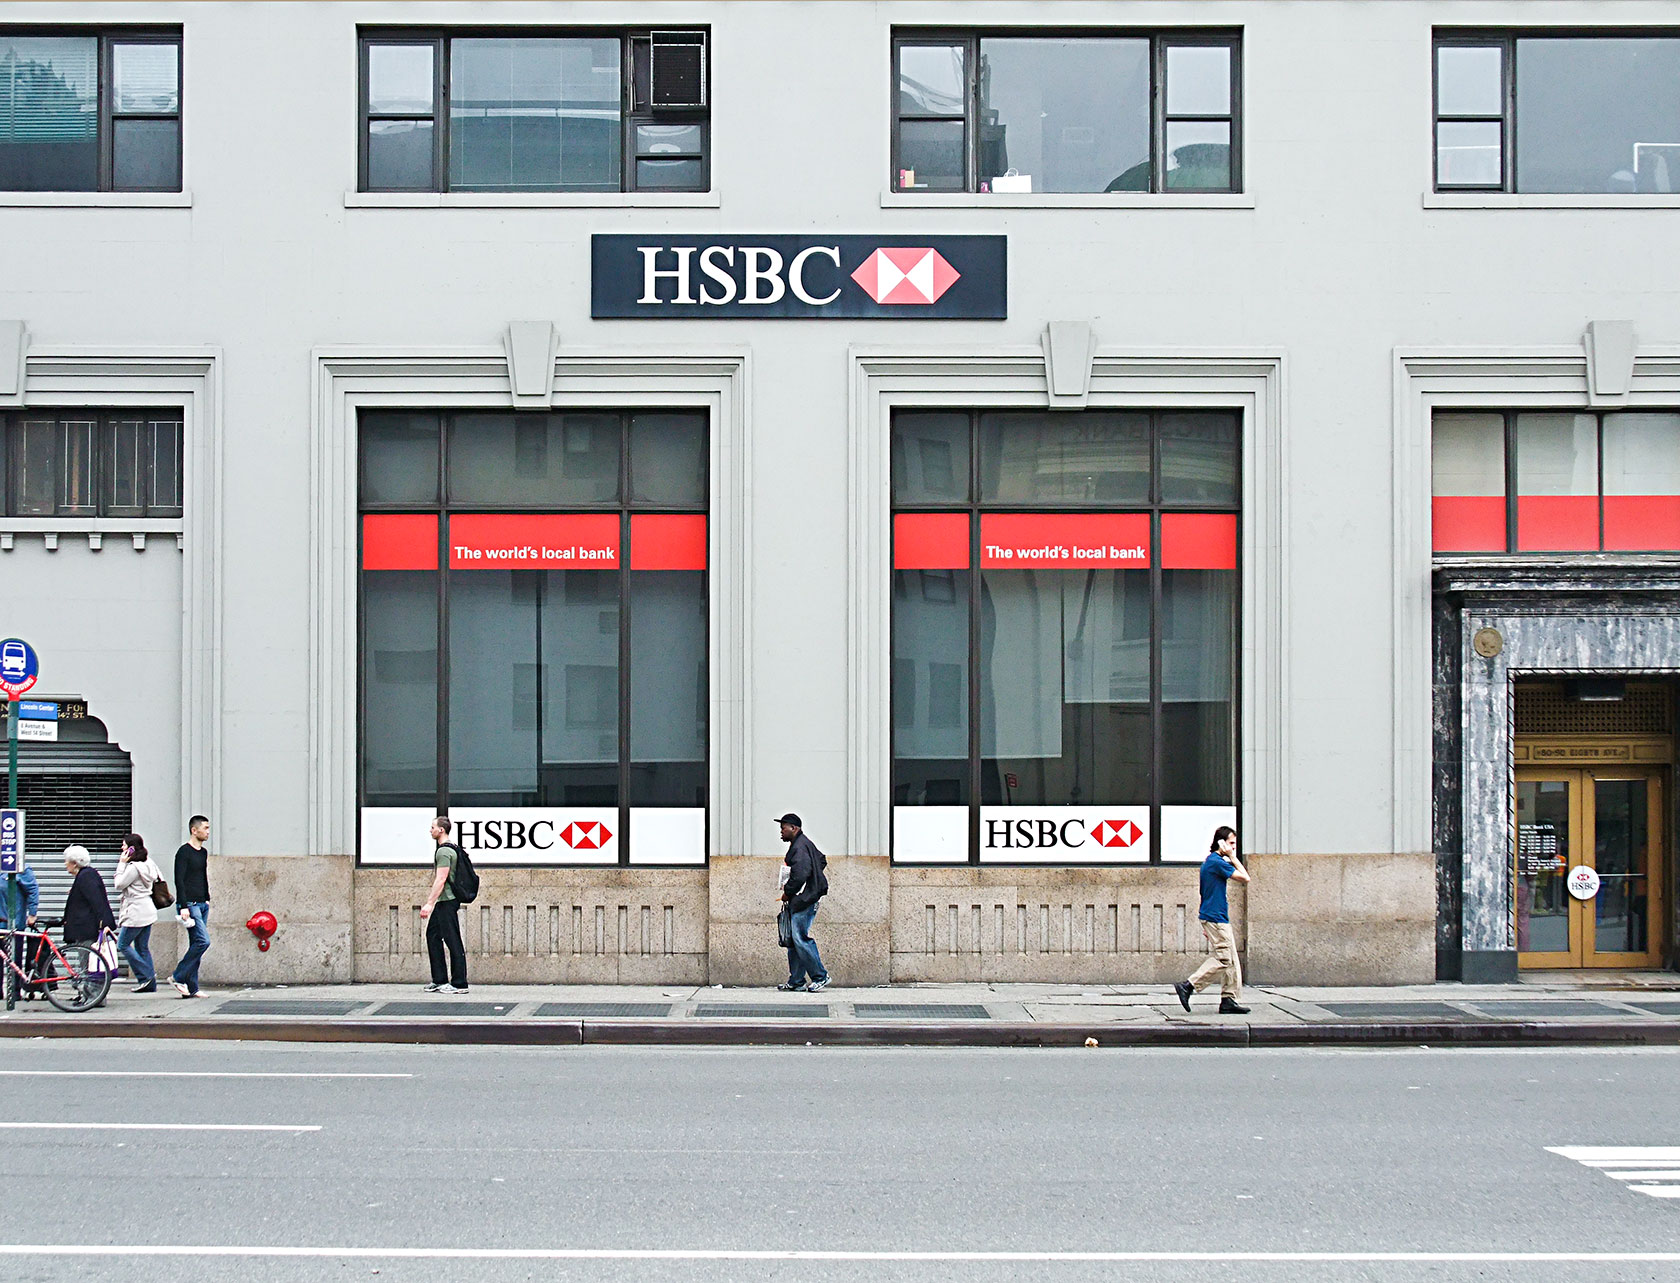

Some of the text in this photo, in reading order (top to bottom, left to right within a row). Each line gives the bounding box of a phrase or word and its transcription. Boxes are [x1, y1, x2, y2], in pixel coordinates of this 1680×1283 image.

[636, 245, 842, 305] HSBC
[454, 546, 615, 559] The world’s local bank
[986, 545, 1146, 559] The world’s local bank
[3, 677, 34, 691] STANDING
[454, 820, 554, 850] HSBC
[985, 819, 1086, 848] HSBC
[1571, 881, 1597, 891] HSBC
